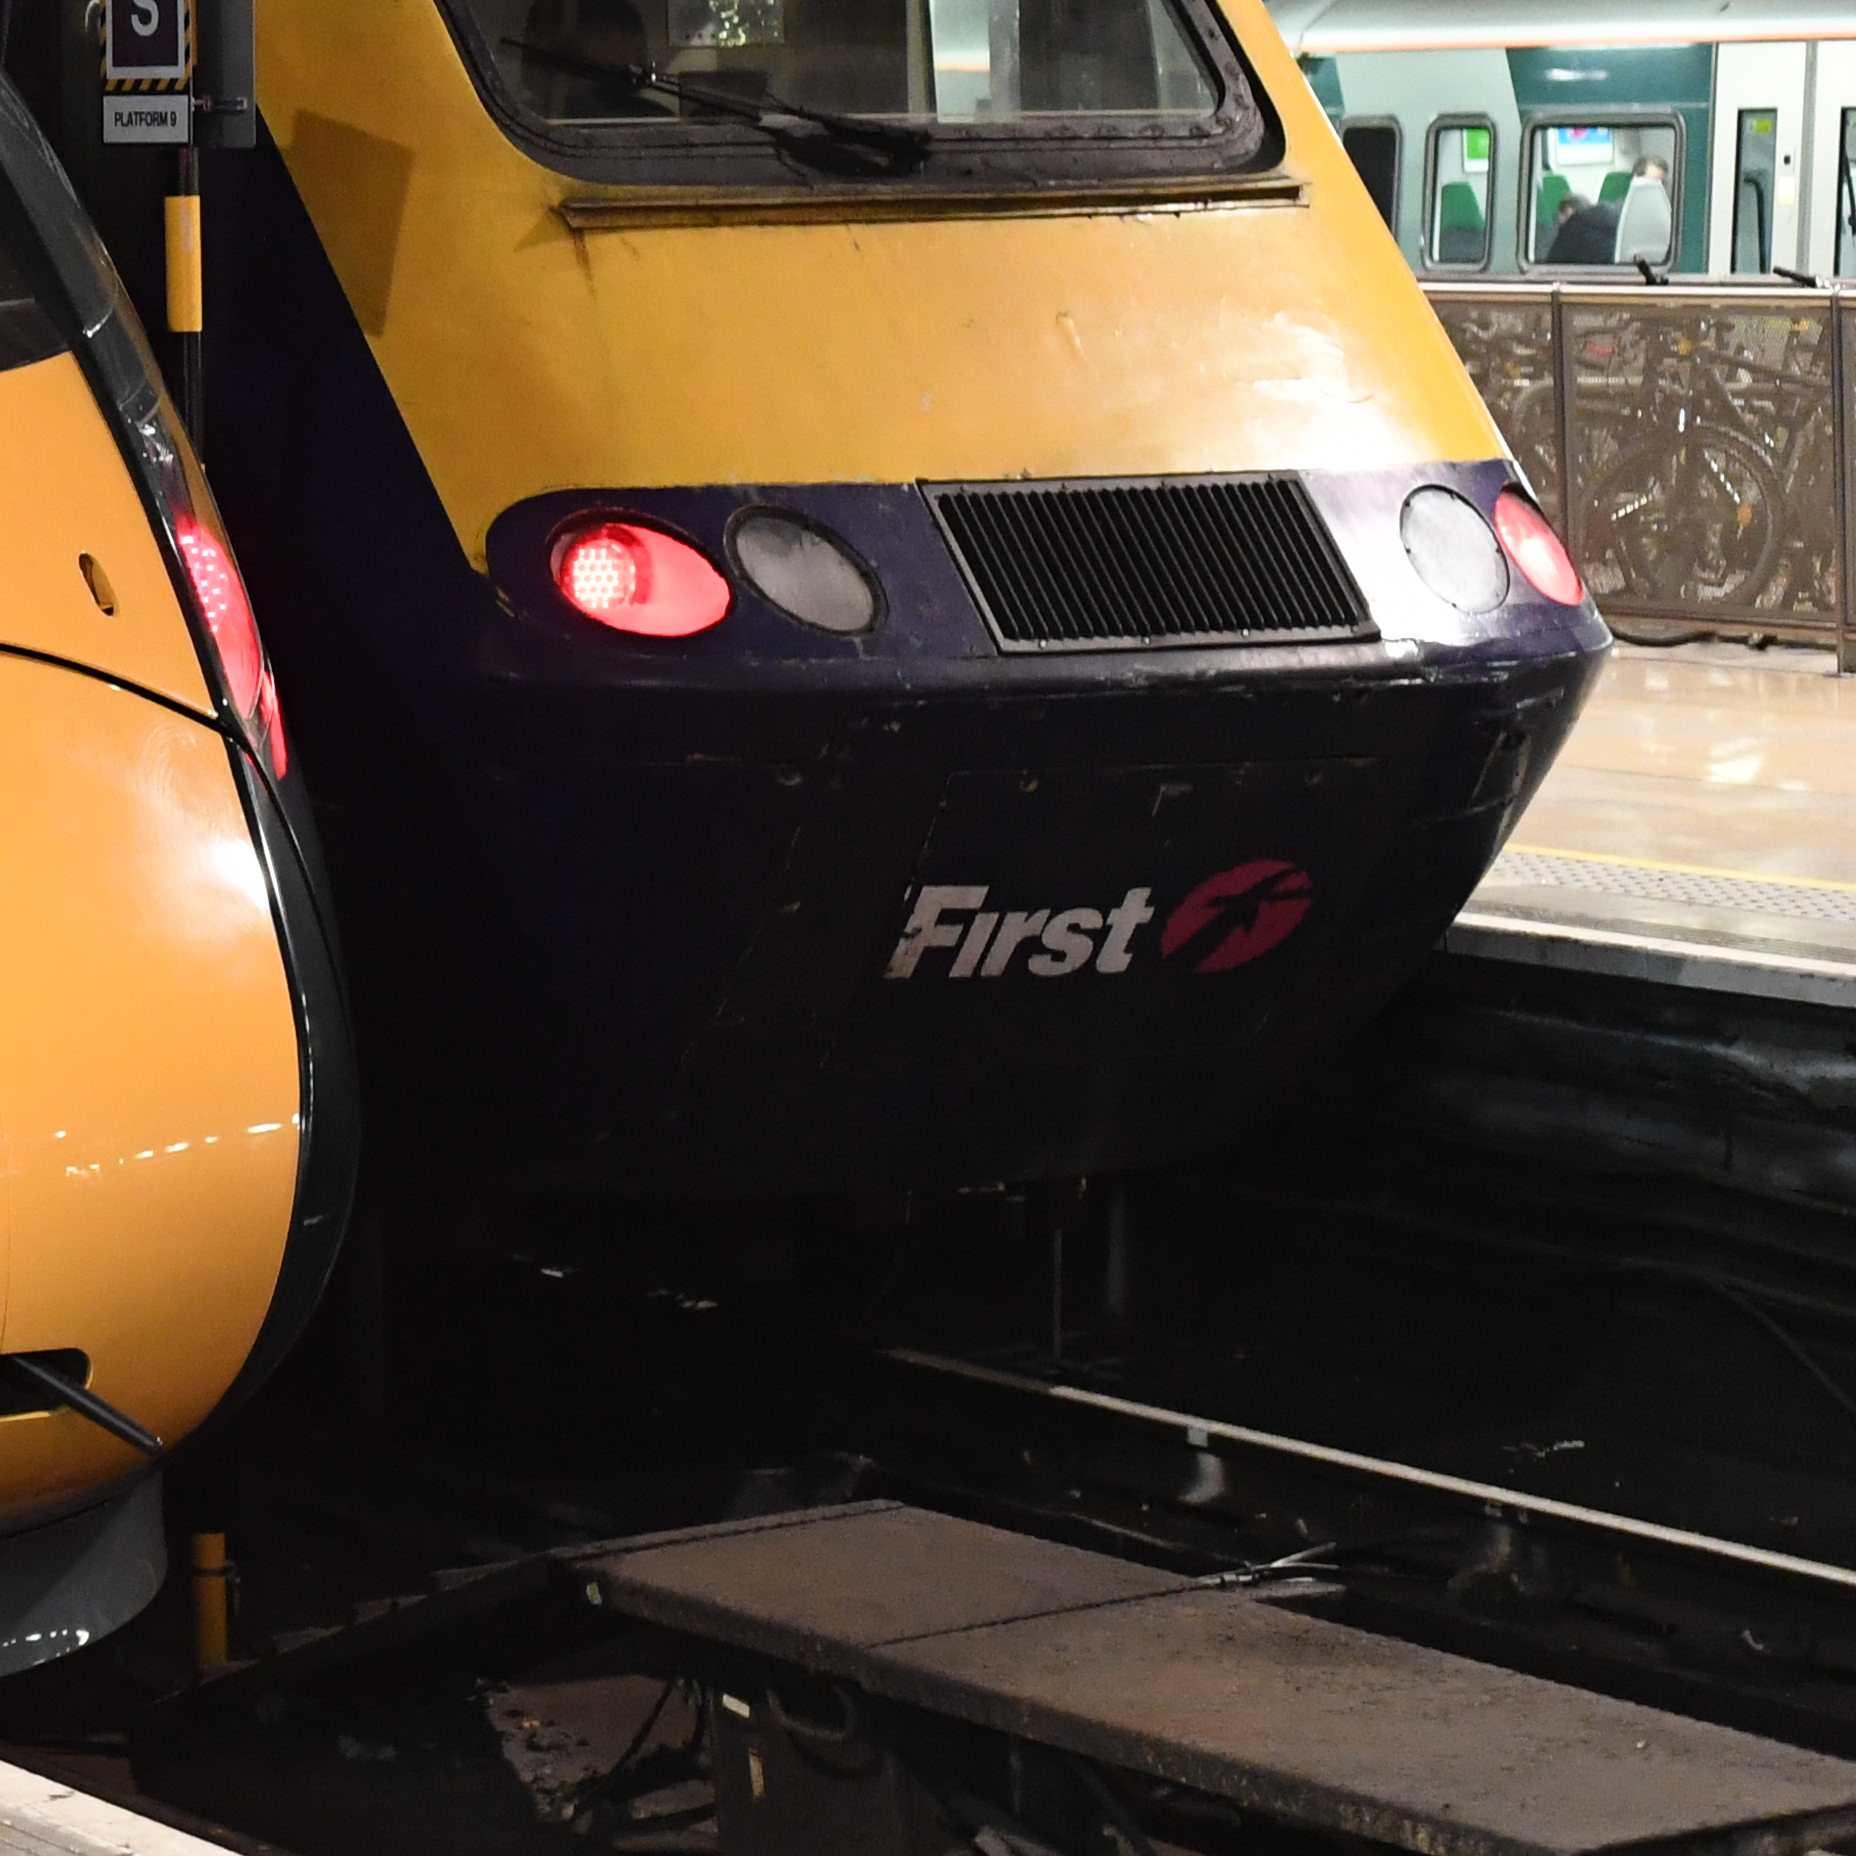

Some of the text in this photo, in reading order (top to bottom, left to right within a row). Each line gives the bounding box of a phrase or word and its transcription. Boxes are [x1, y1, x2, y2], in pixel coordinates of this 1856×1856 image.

[114, 111, 177, 127] PLATFORM 9
[882, 885, 1155, 977] First
